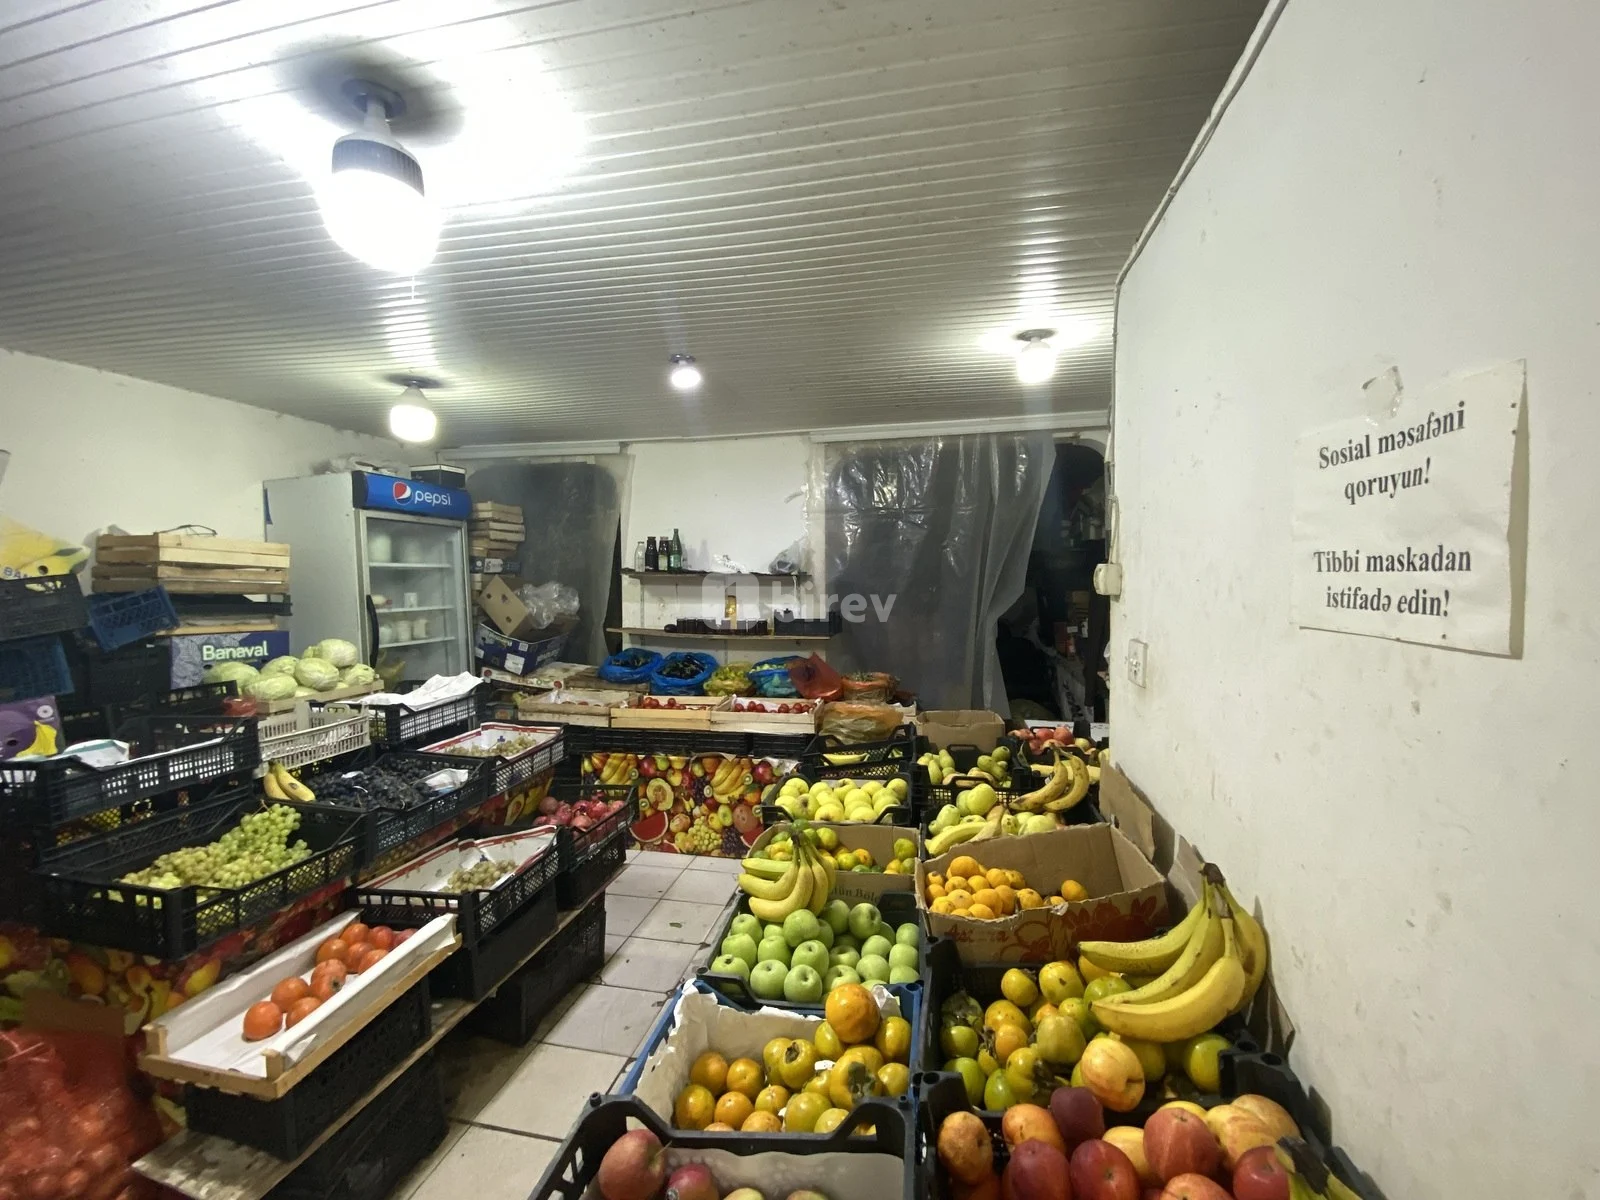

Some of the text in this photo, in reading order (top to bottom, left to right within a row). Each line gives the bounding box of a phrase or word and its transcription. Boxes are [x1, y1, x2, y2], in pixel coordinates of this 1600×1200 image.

[1319, 401, 1465, 469] Sosial məsafəni
[1344, 457, 1431, 505] qoruyun!
[414, 490, 452, 507] pepsi
[1313, 545, 1472, 573] Tibbi maskadan
[1326, 586, 1450, 617] istifadə edin!
[202, 640, 269, 661] Banaval
